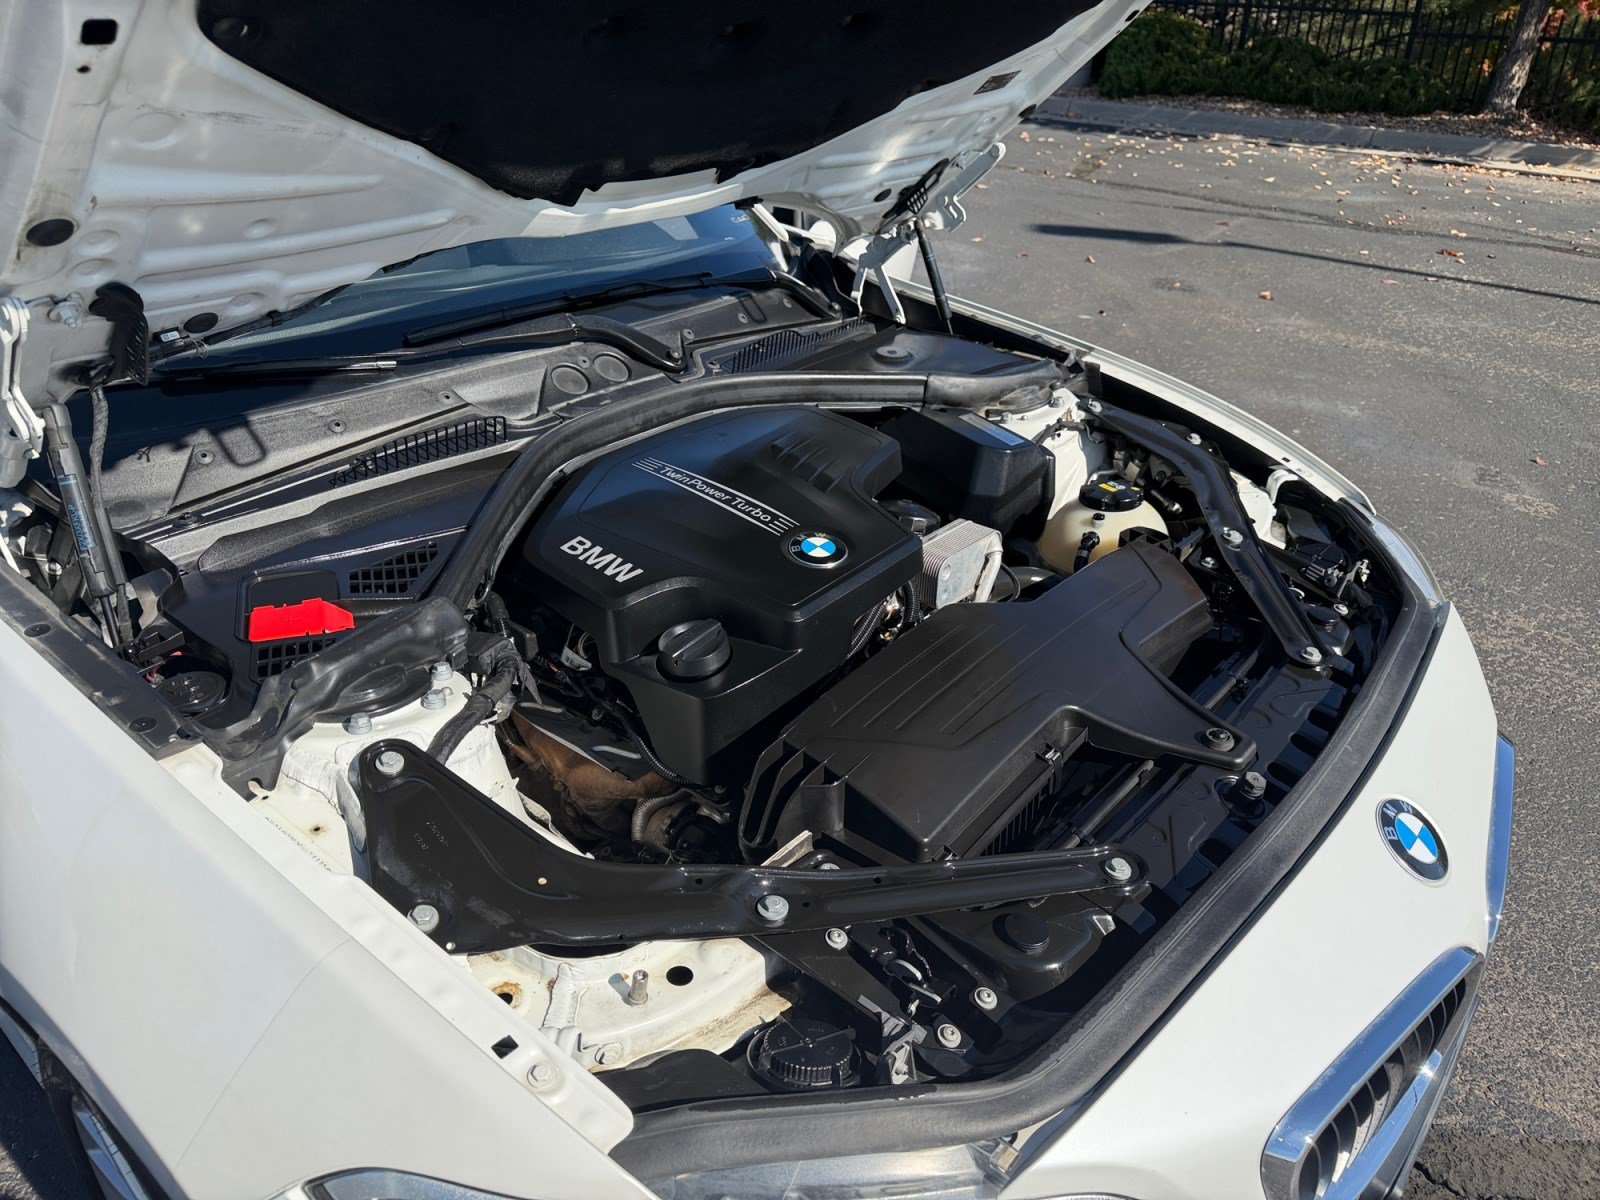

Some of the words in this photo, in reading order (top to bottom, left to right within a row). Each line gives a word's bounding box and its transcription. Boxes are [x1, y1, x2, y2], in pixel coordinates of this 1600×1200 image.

[659, 466, 732, 500] TwinPower
[732, 496, 772, 522] Turbo
[559, 535, 645, 583] BMW
[791, 532, 826, 552] BMW
[1383, 800, 1413, 841] BMW
